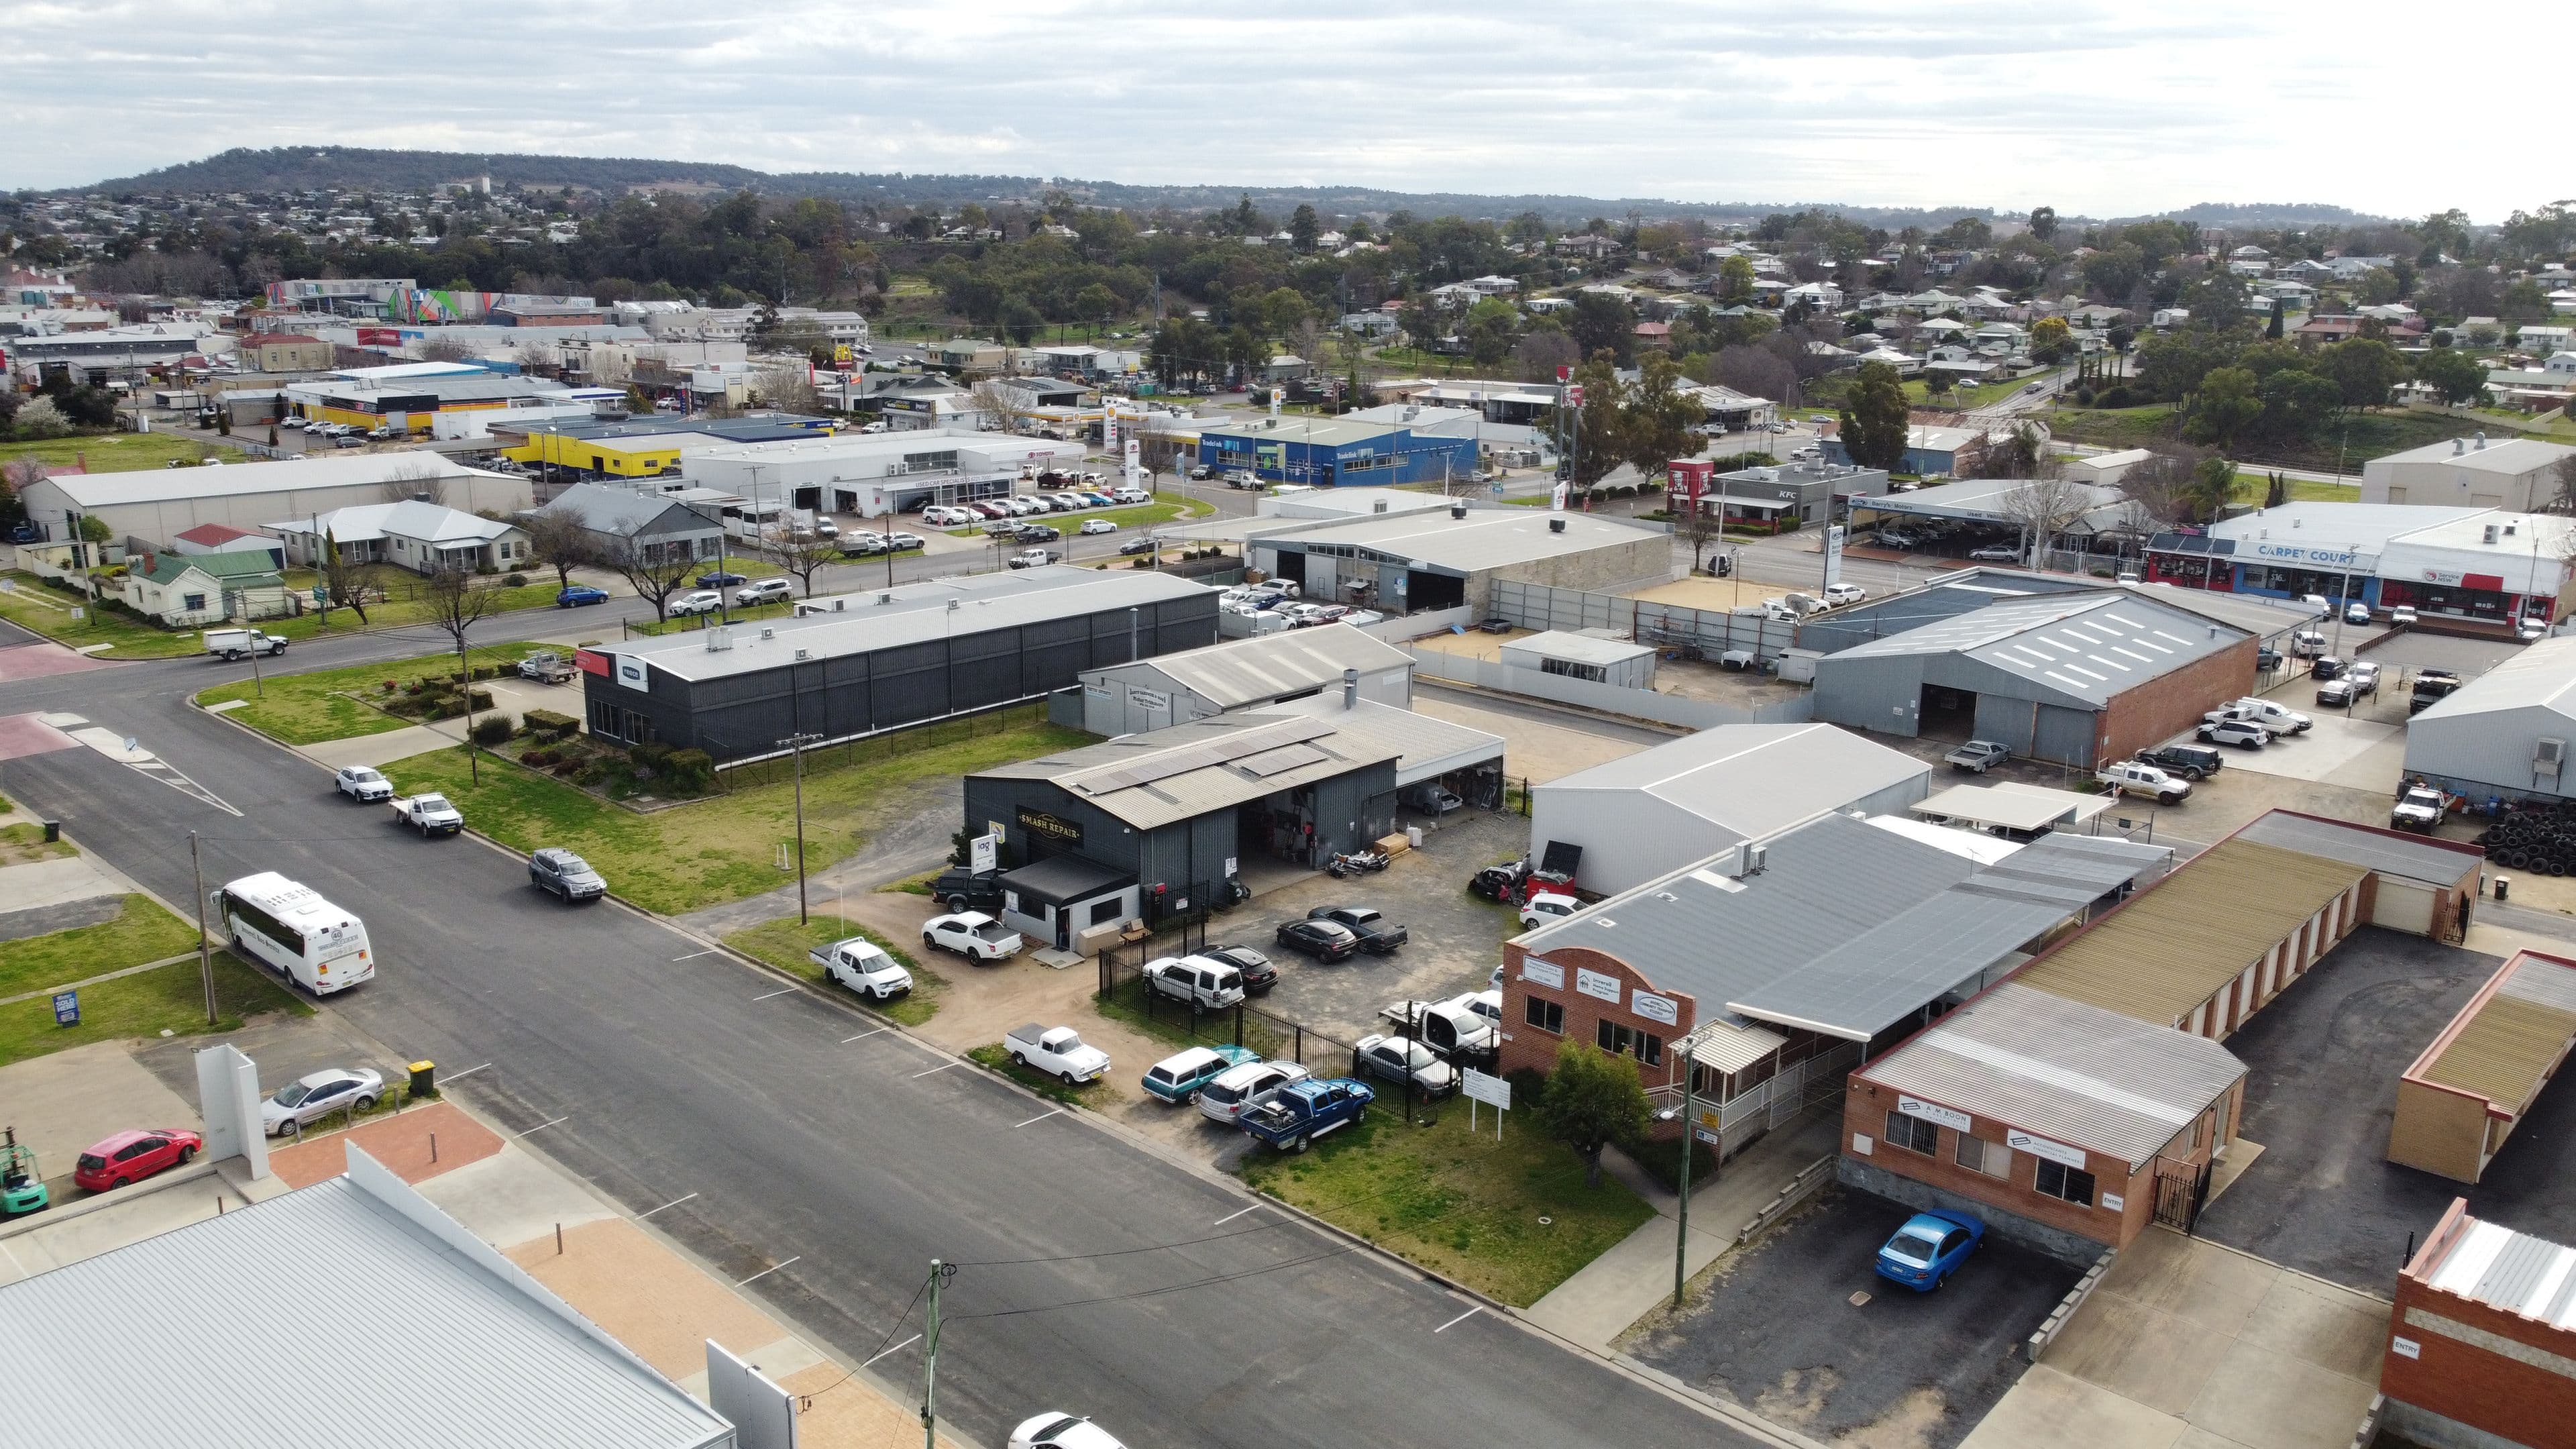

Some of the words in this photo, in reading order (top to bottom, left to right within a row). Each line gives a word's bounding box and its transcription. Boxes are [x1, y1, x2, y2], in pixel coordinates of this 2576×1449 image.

[1202, 439, 1222, 448] Tradelink
[941, 476, 971, 485] SPECIALISS
[1778, 490, 1796, 498] KFC
[2259, 545, 2308, 559] CARPET
[2310, 551, 2357, 564] COURT
[624, 668, 639, 678] reece
[1021, 814, 1047, 828] SMASH
[1049, 820, 1077, 839] REPAIR
[977, 841, 990, 852] iag
[1593, 977, 1612, 987] Inverell
[1593, 988, 1609, 996] Program
[1604, 986, 1619, 994] Support
[1945, 1111, 1966, 1122] BOON
[2104, 1197, 2122, 1207] ENTRY
[2395, 1342, 2418, 1353] ENTRY
